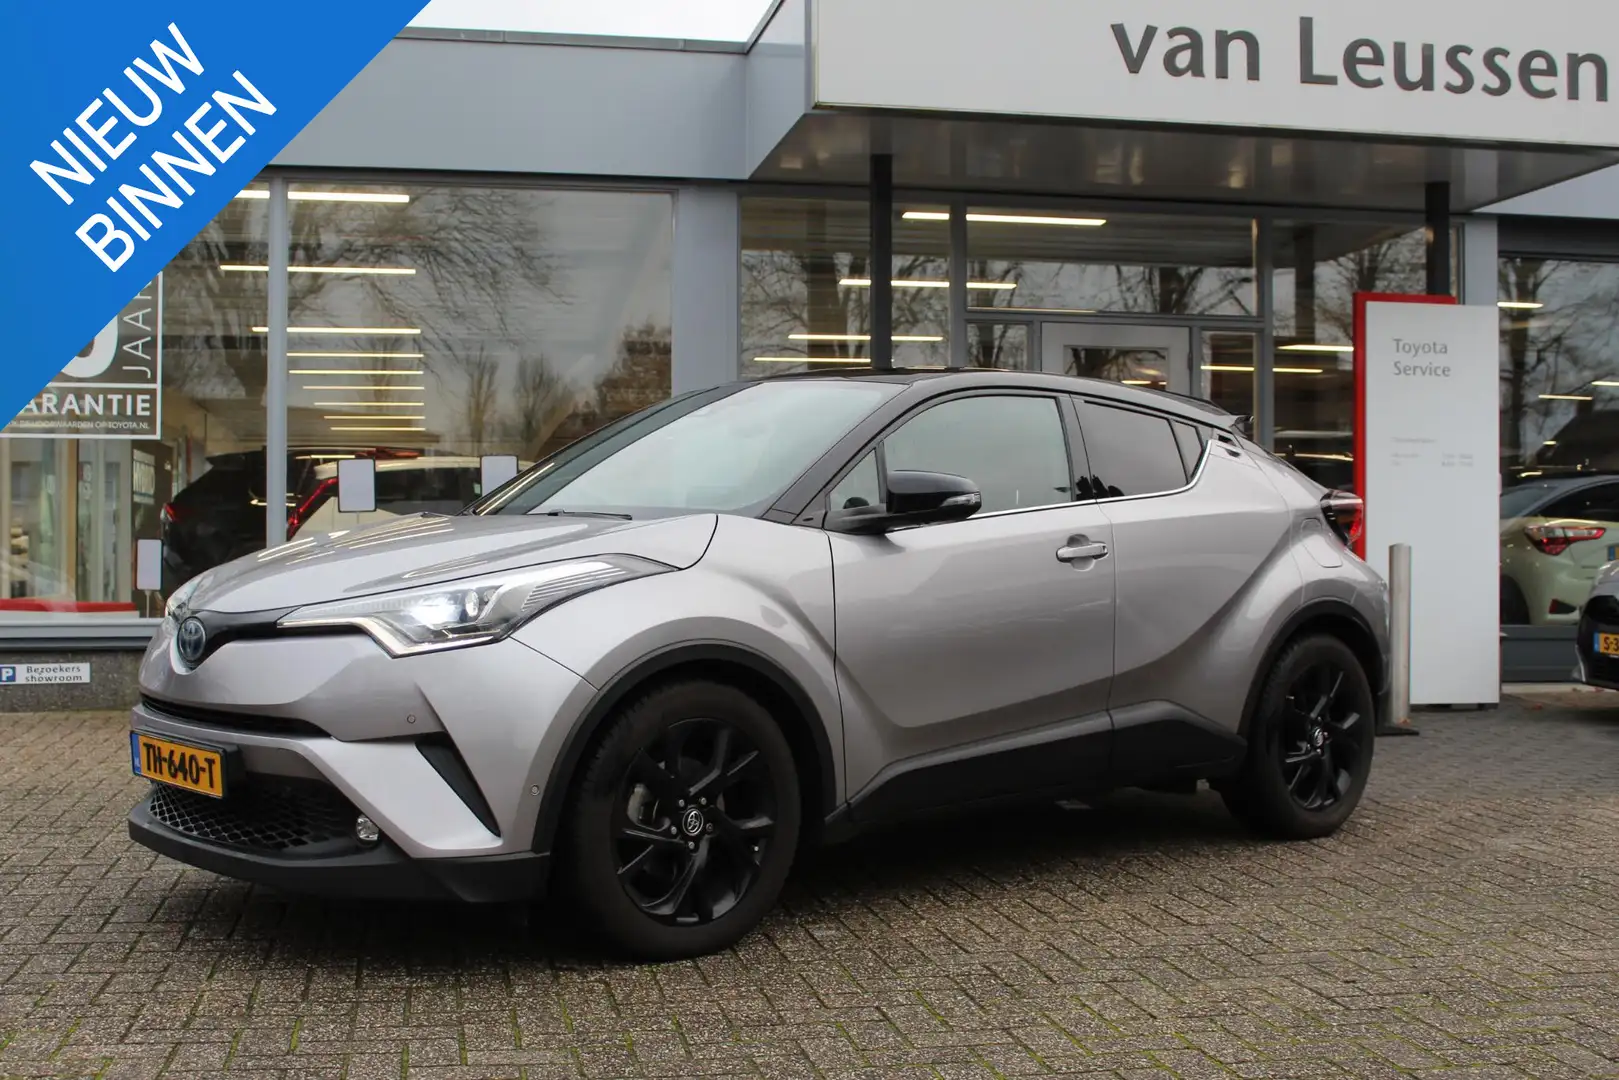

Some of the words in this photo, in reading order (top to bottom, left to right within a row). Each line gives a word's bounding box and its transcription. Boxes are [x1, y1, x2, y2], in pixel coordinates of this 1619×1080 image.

[1110, 22, 1260, 81] van
[1300, 16, 1608, 102] Leussen
[1392, 338, 1448, 358] Toyota
[1393, 360, 1451, 377] Service
[18, 393, 151, 416] ARANTIE
[25, 674, 83, 682] showroom
[26, 664, 81, 674] Bezoekers
[143, 742, 216, 788] TH-640-T
